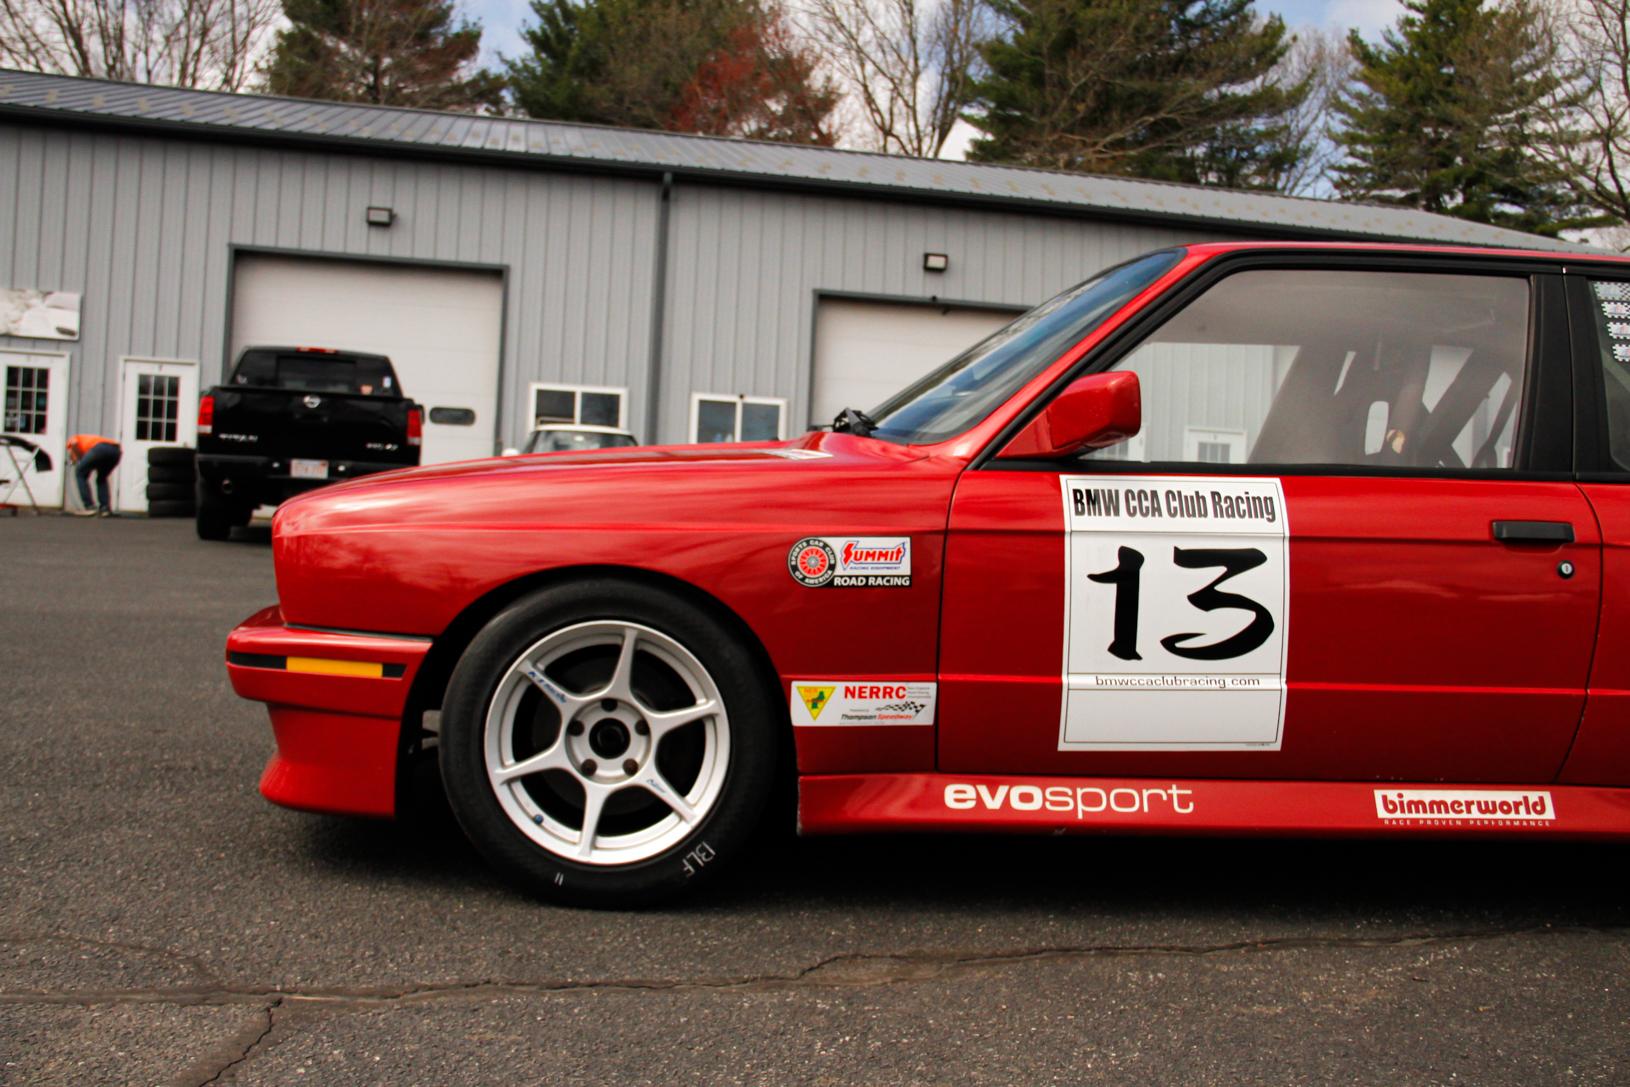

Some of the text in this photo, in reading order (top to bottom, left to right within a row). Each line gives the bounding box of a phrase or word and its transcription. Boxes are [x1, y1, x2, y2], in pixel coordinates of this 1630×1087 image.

[1072, 488, 1276, 523] BMW CCA Club Racing
[809, 539, 824, 548] CAR
[833, 576, 911, 587] ROAD RACING
[1086, 545, 1275, 661] 13
[1095, 675, 1261, 689] bmwccaclubracing.com
[844, 685, 907, 700] NERRC
[943, 783, 1195, 820] evosport
[1381, 792, 1547, 816] bimmerworld
[1419, 819, 1462, 827] PROVEN
